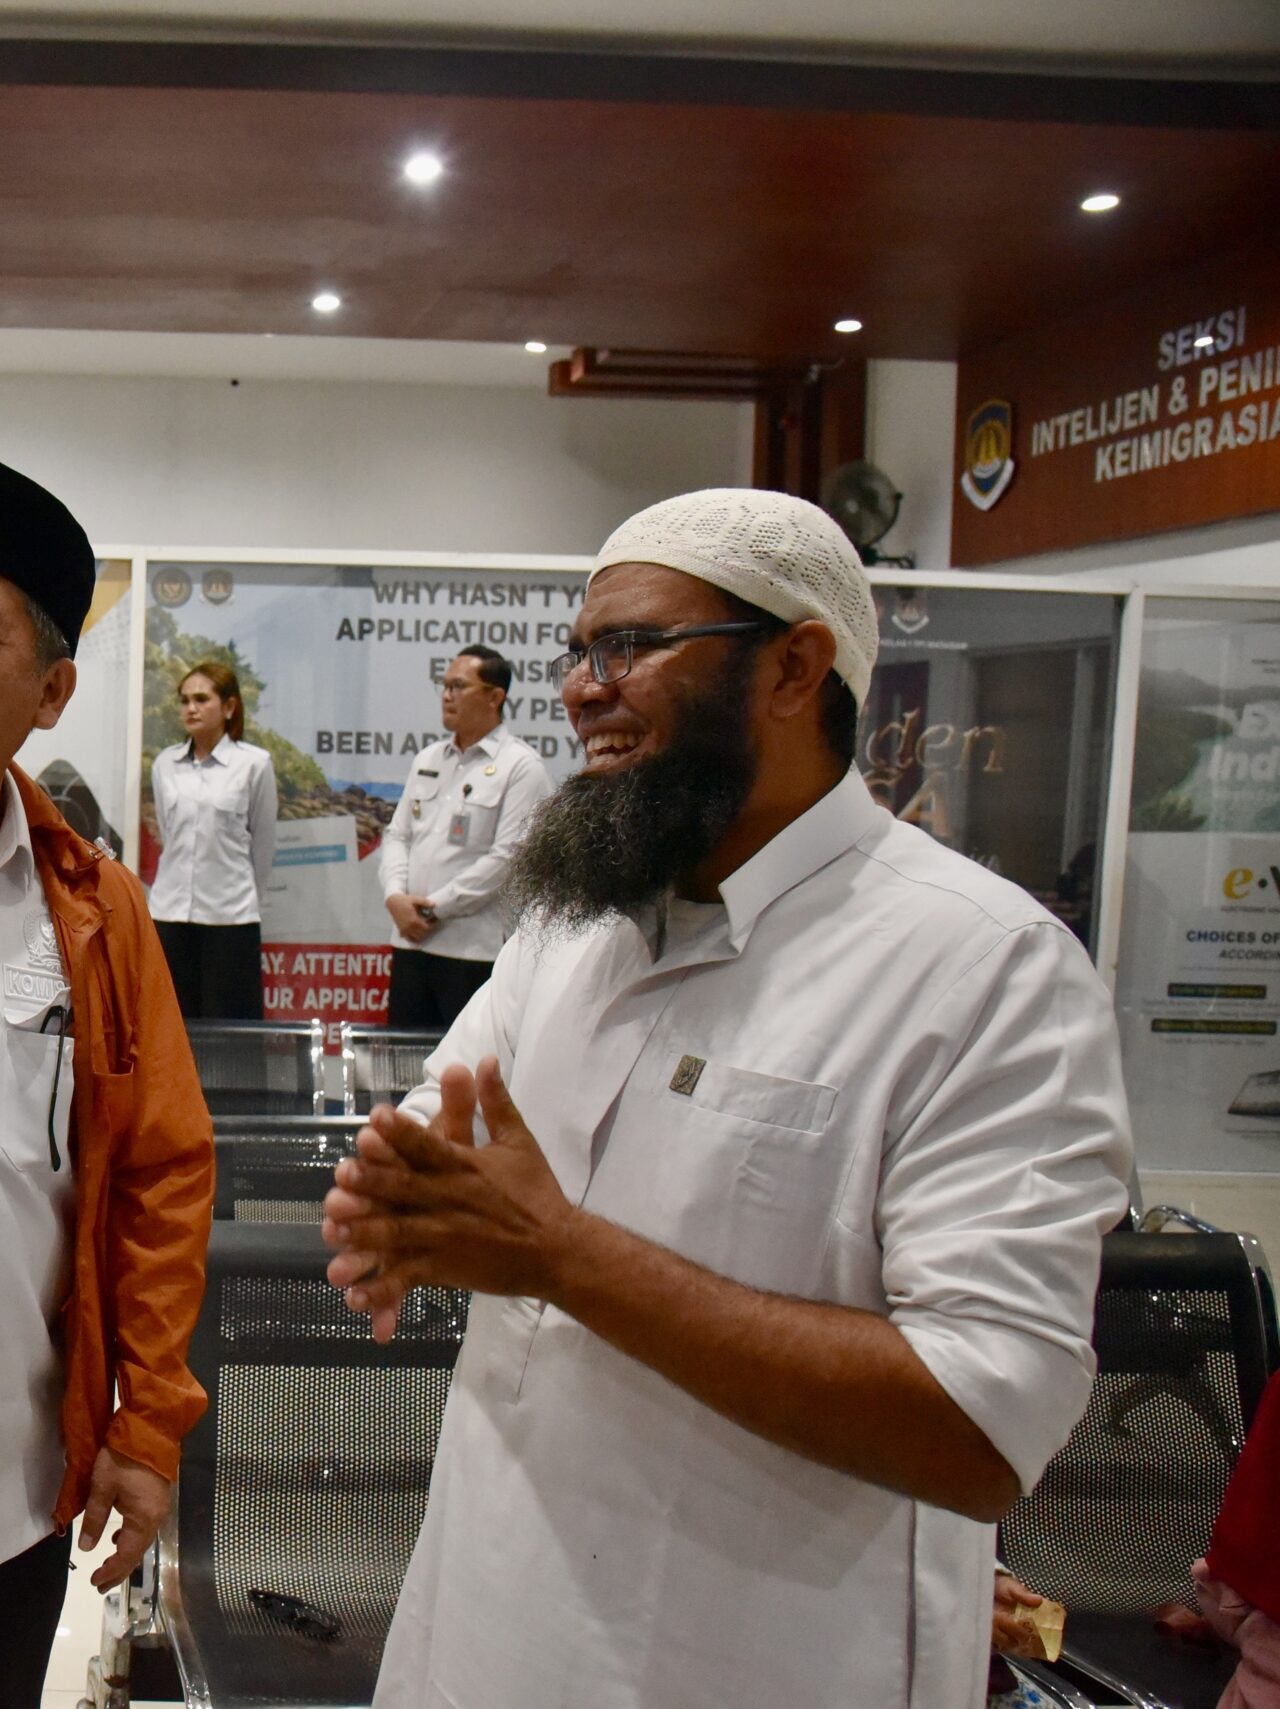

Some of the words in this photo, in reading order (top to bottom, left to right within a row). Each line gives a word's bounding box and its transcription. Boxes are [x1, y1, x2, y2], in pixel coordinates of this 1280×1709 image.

[1158, 305, 1246, 371] SEKSI
[1031, 384, 1160, 457] INTELIJEN
[1168, 376, 1190, 417] &
[1199, 345, 1280, 407] PENI
[373, 581, 442, 604] WHY
[336, 616, 528, 645] APPLICATION
[536, 622, 570, 646] FO
[317, 731, 394, 756] BEEN
[865, 706, 1006, 773] den
[1186, 930, 1257, 944] CHOICES
[263, 986, 295, 1010] UR
